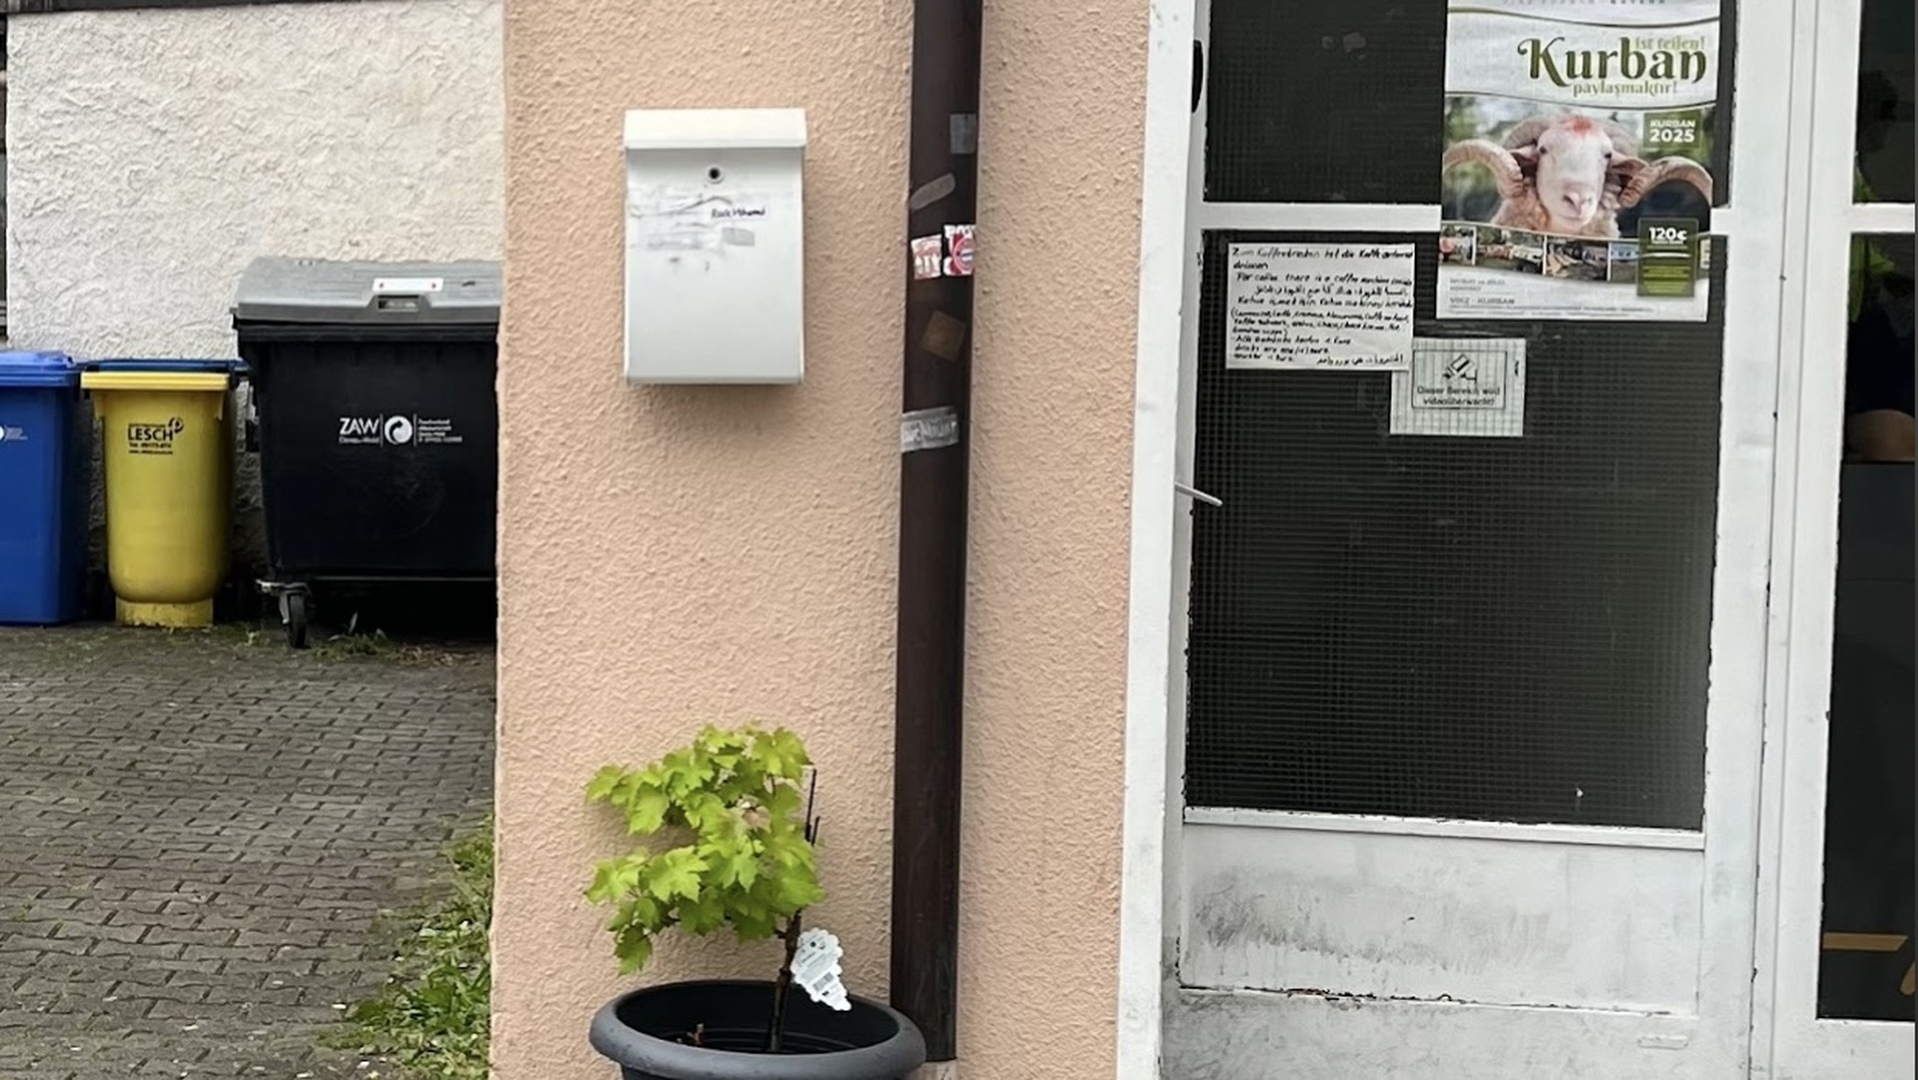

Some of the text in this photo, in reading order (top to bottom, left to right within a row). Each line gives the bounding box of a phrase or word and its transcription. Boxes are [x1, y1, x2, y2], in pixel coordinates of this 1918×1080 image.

[1517, 36, 1706, 87] Kurban
[1650, 119, 1696, 128] KURBAN
[1650, 128, 1695, 143] 2025
[1416, 385, 1445, 395] Dieser
[339, 418, 379, 435] ZAW
[128, 427, 173, 441] LESCH
